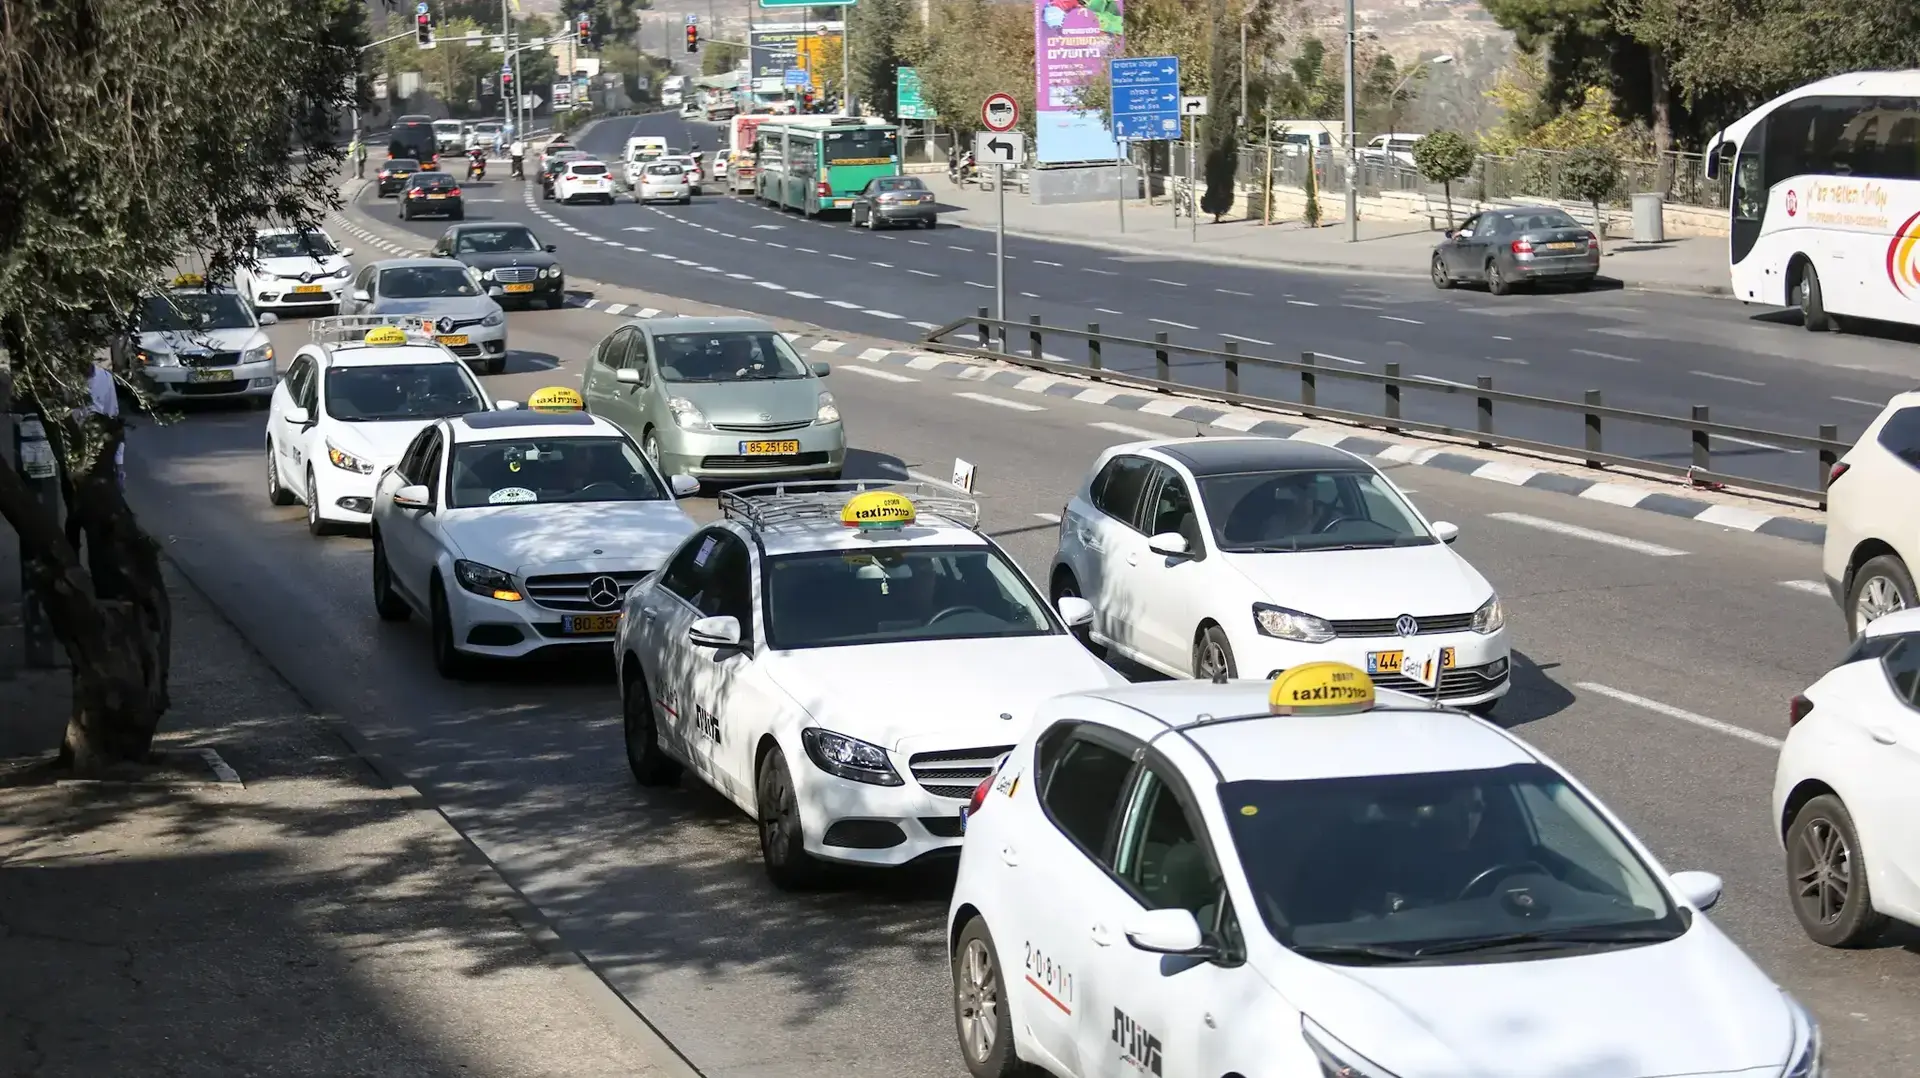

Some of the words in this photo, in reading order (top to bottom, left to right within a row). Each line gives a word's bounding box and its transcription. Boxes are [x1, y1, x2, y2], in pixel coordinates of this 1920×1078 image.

[557, 396, 578, 404] מונית
[855, 505, 881, 519] taxi
[882, 507, 910, 517] מונית
[1292, 682, 1328, 701] taxi
[1330, 686, 1367, 699] מונית
